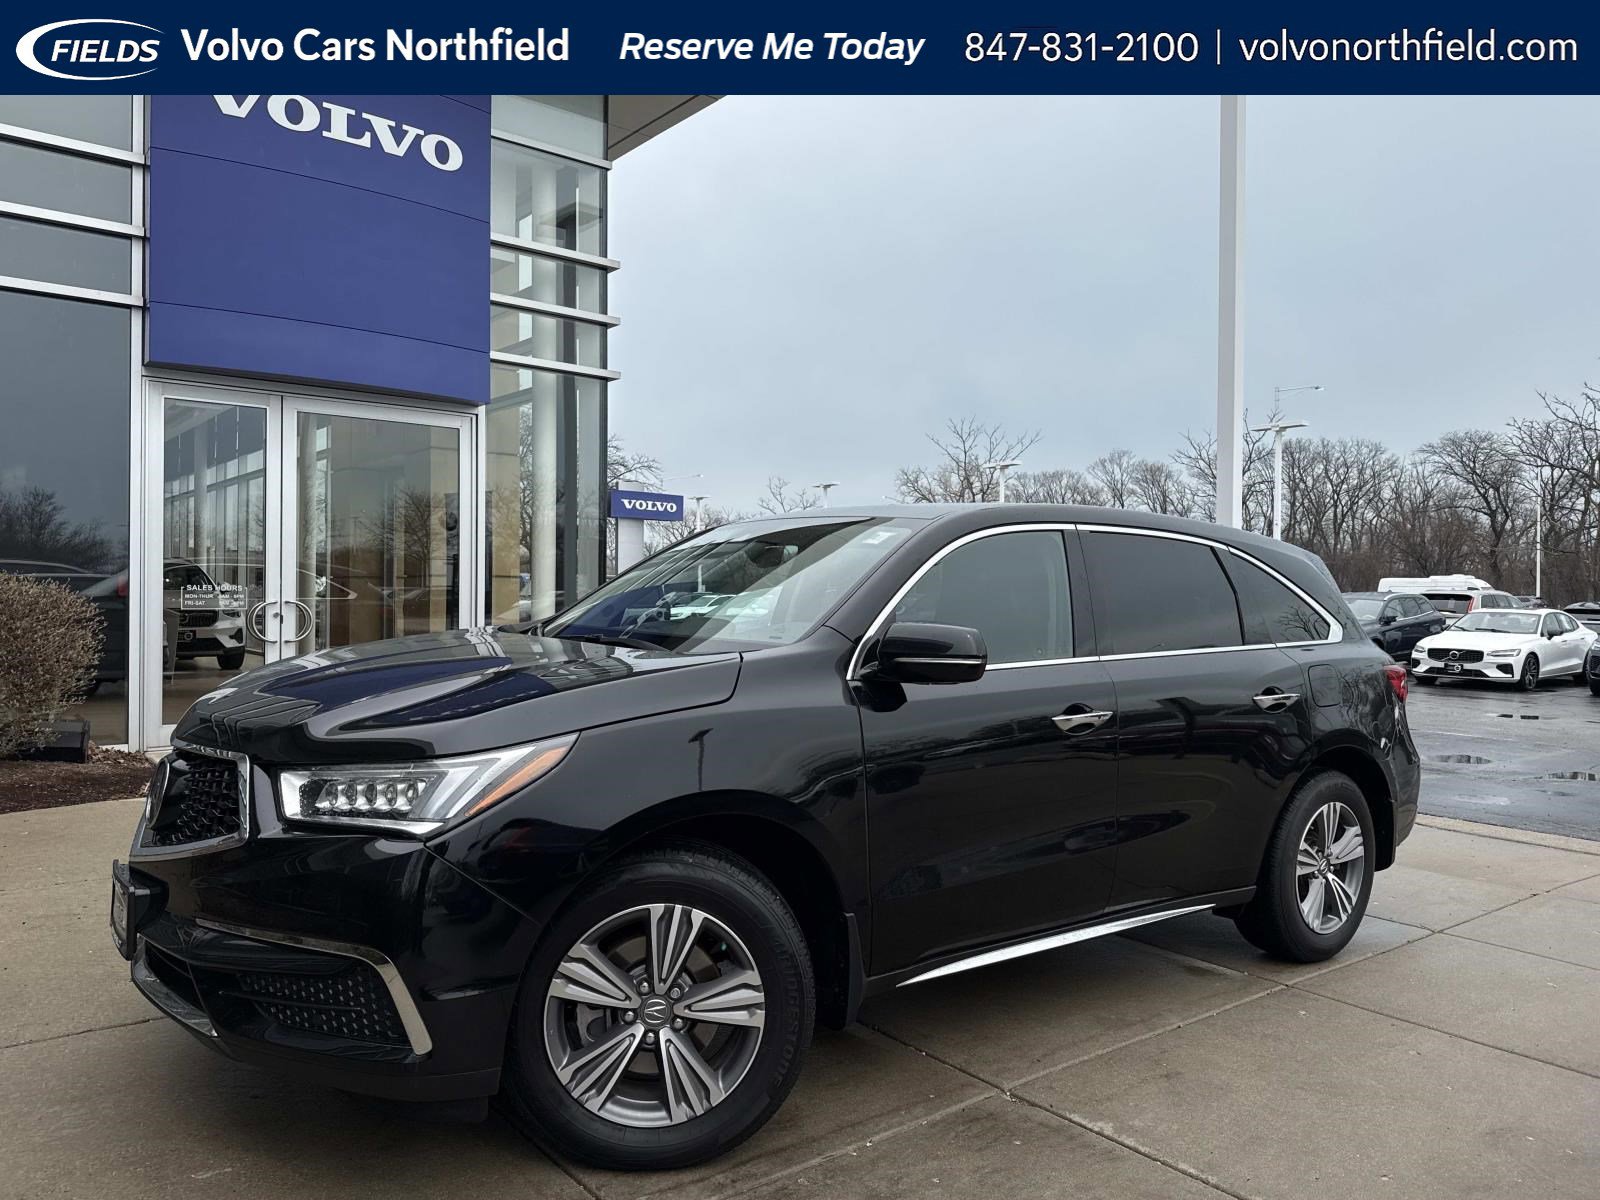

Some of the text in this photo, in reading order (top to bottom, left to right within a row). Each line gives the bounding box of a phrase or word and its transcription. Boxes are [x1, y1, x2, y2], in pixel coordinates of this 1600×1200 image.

[213, 94, 464, 172] VOLVO
[620, 498, 677, 513] VOLVO
[215, 584, 243, 592] HOURS
